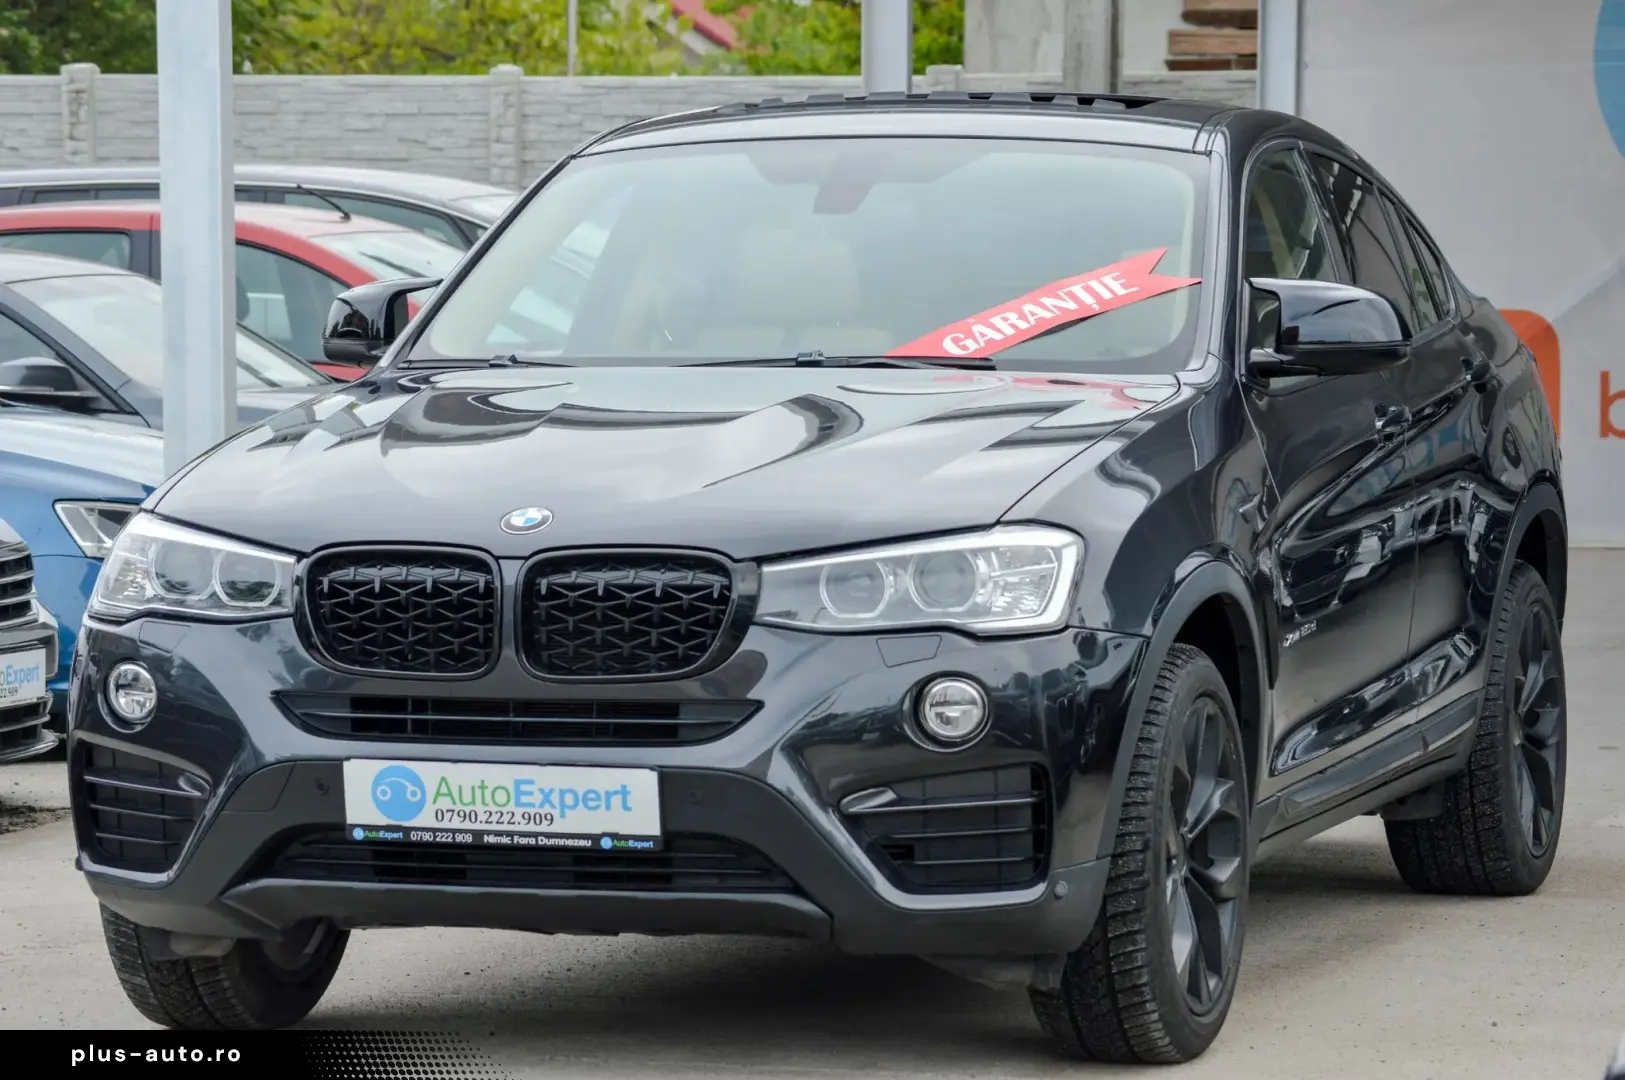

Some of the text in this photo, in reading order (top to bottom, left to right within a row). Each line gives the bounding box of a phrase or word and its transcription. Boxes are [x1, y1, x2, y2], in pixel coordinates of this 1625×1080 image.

[942, 271, 1140, 356] GARANȚIE
[432, 776, 632, 819] AutoExpert
[435, 808, 554, 827] 0790.222.909
[364, 830, 654, 849] AutoExpert 0790 222 909 Nimic Fara Dumnezeu AutoExpert
